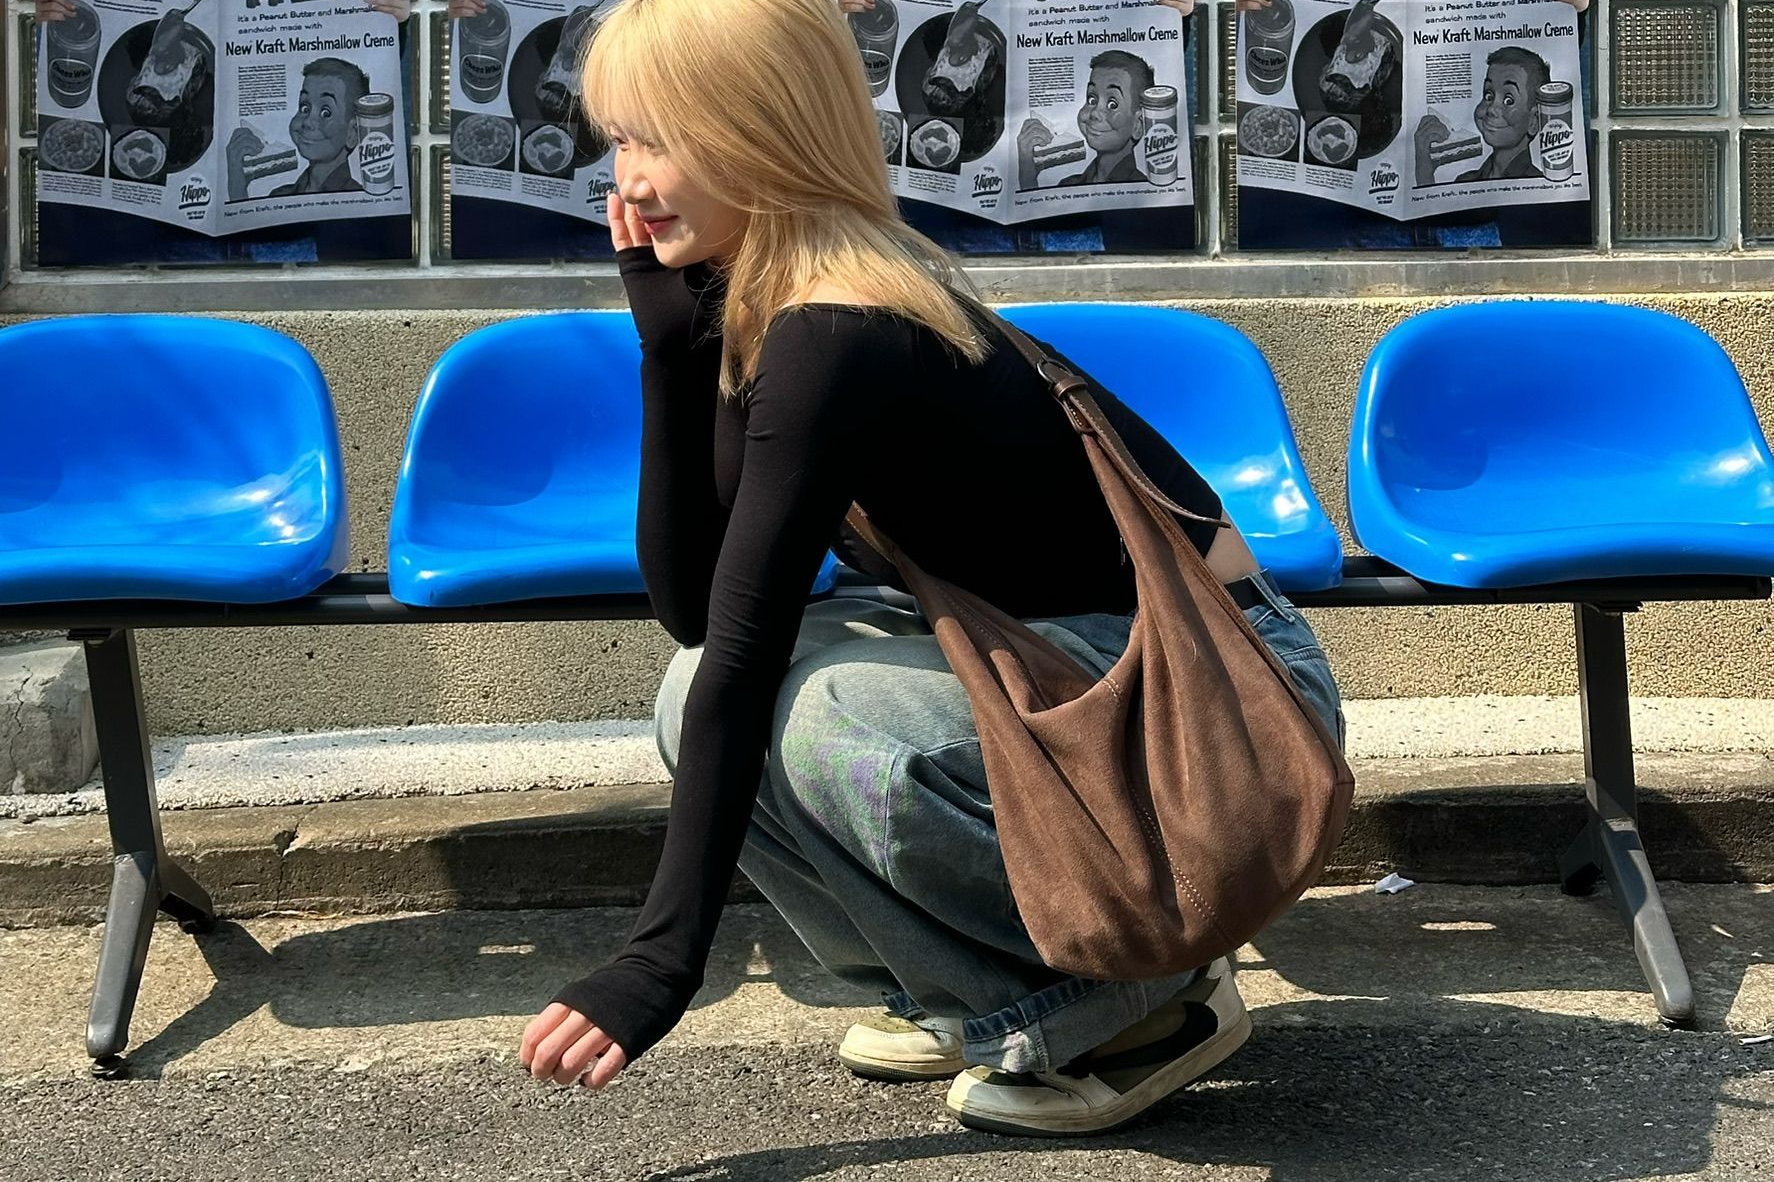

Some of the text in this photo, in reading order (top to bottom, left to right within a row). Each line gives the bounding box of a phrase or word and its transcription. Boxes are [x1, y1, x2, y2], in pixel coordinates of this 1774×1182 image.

[1029, 15, 1110, 27] sandwich made with
[1426, 14, 1462, 24] sandwich
[1466, 13, 1487, 21] made
[238, 25, 277, 34] sandwich
[281, 23, 303, 32] made
[1017, 25, 1178, 48] New Kraft Marshmallow Creme
[1413, 22, 1574, 45] New Kraft Marshmallow Creme
[225, 32, 394, 56] New Kraft Marshmallow Creme
